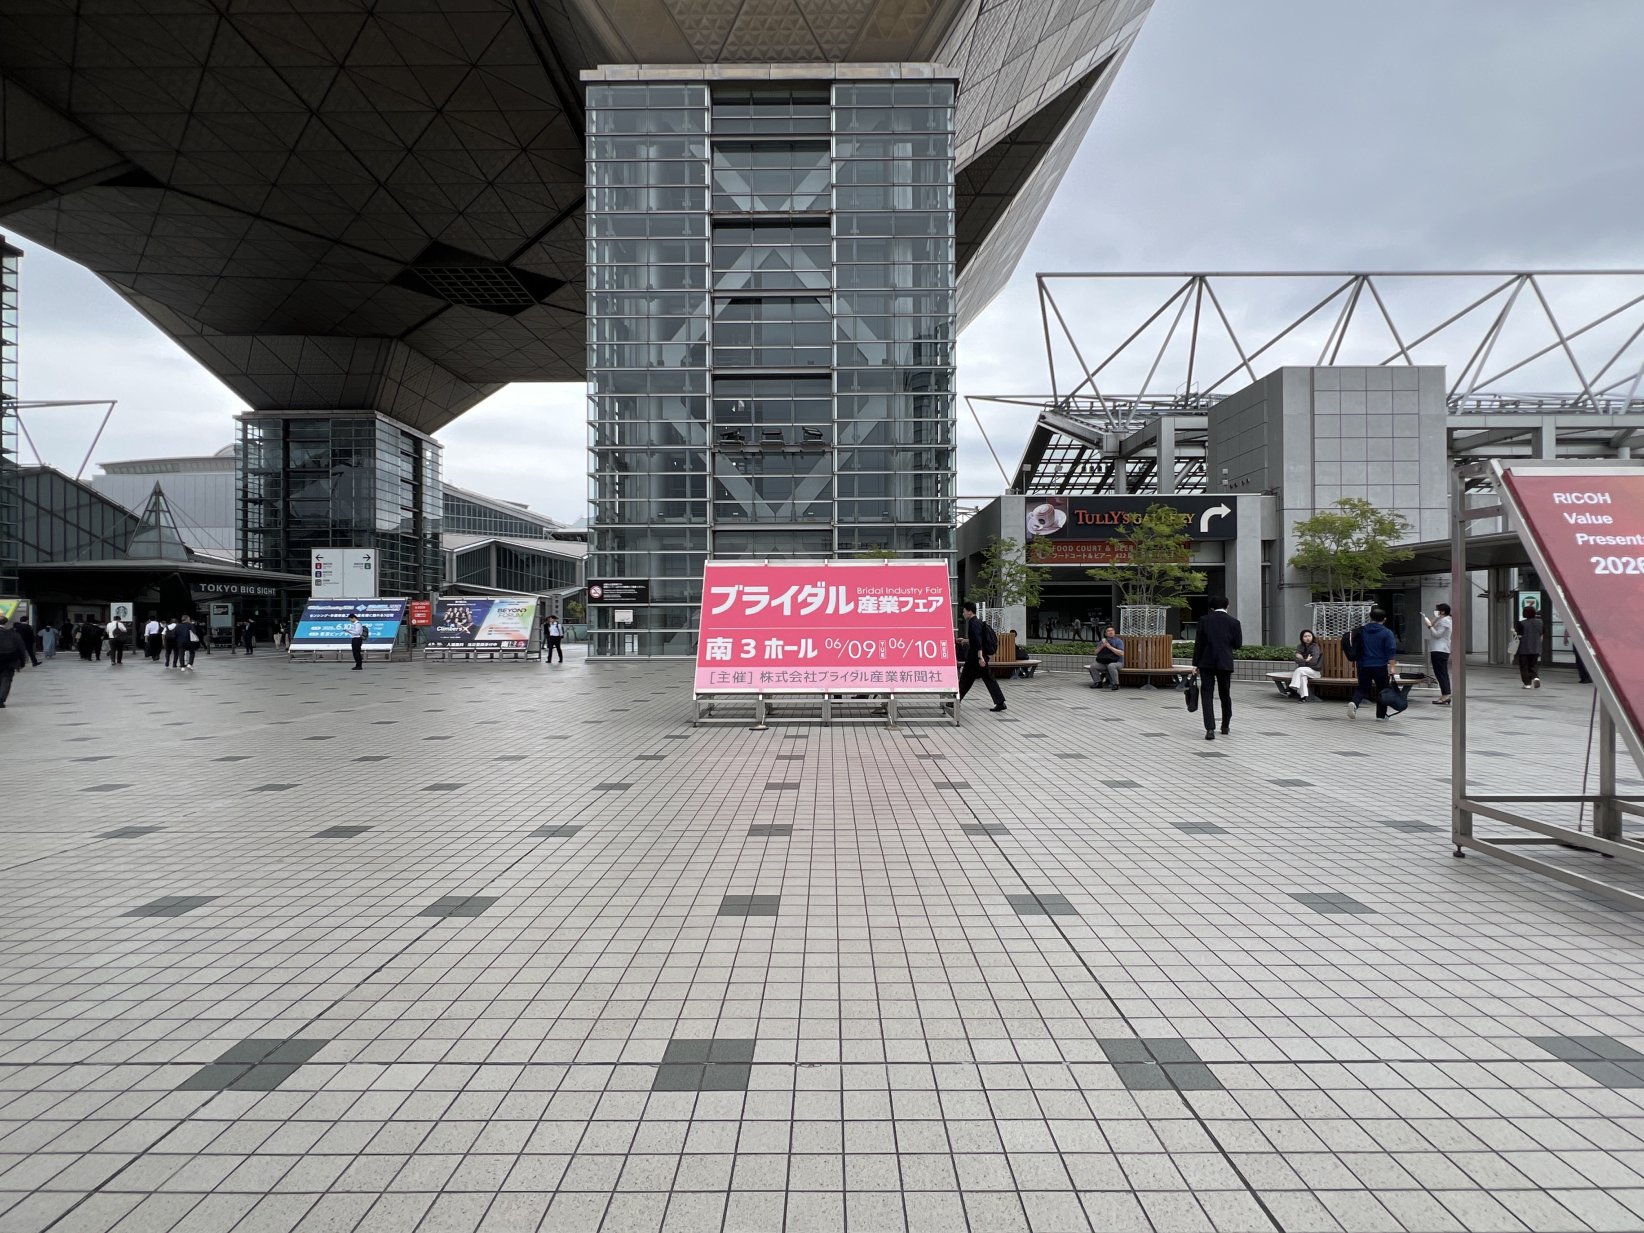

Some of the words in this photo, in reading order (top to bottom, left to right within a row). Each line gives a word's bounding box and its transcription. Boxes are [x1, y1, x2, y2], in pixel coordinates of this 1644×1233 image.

[1552, 493, 1612, 504] RICOH
[1563, 512, 1614, 524] Value
[1576, 533, 1644, 545] Present
[200, 584, 238, 593] TOKYO
[241, 586, 255, 594] BIG
[257, 587, 275, 595] SIGHT
[857, 587, 884, 595] Bridal
[885, 587, 923, 596] Industry
[925, 587, 943, 595] Fair
[710, 581, 855, 616] ブライダル
[857, 595, 944, 614] 産業フェア
[706, 636, 733, 660] 南
[740, 638, 756, 658] 3
[764, 638, 818, 659] ホール
[760, 670, 943, 684] 株式会社ブライダル産業新聞社
